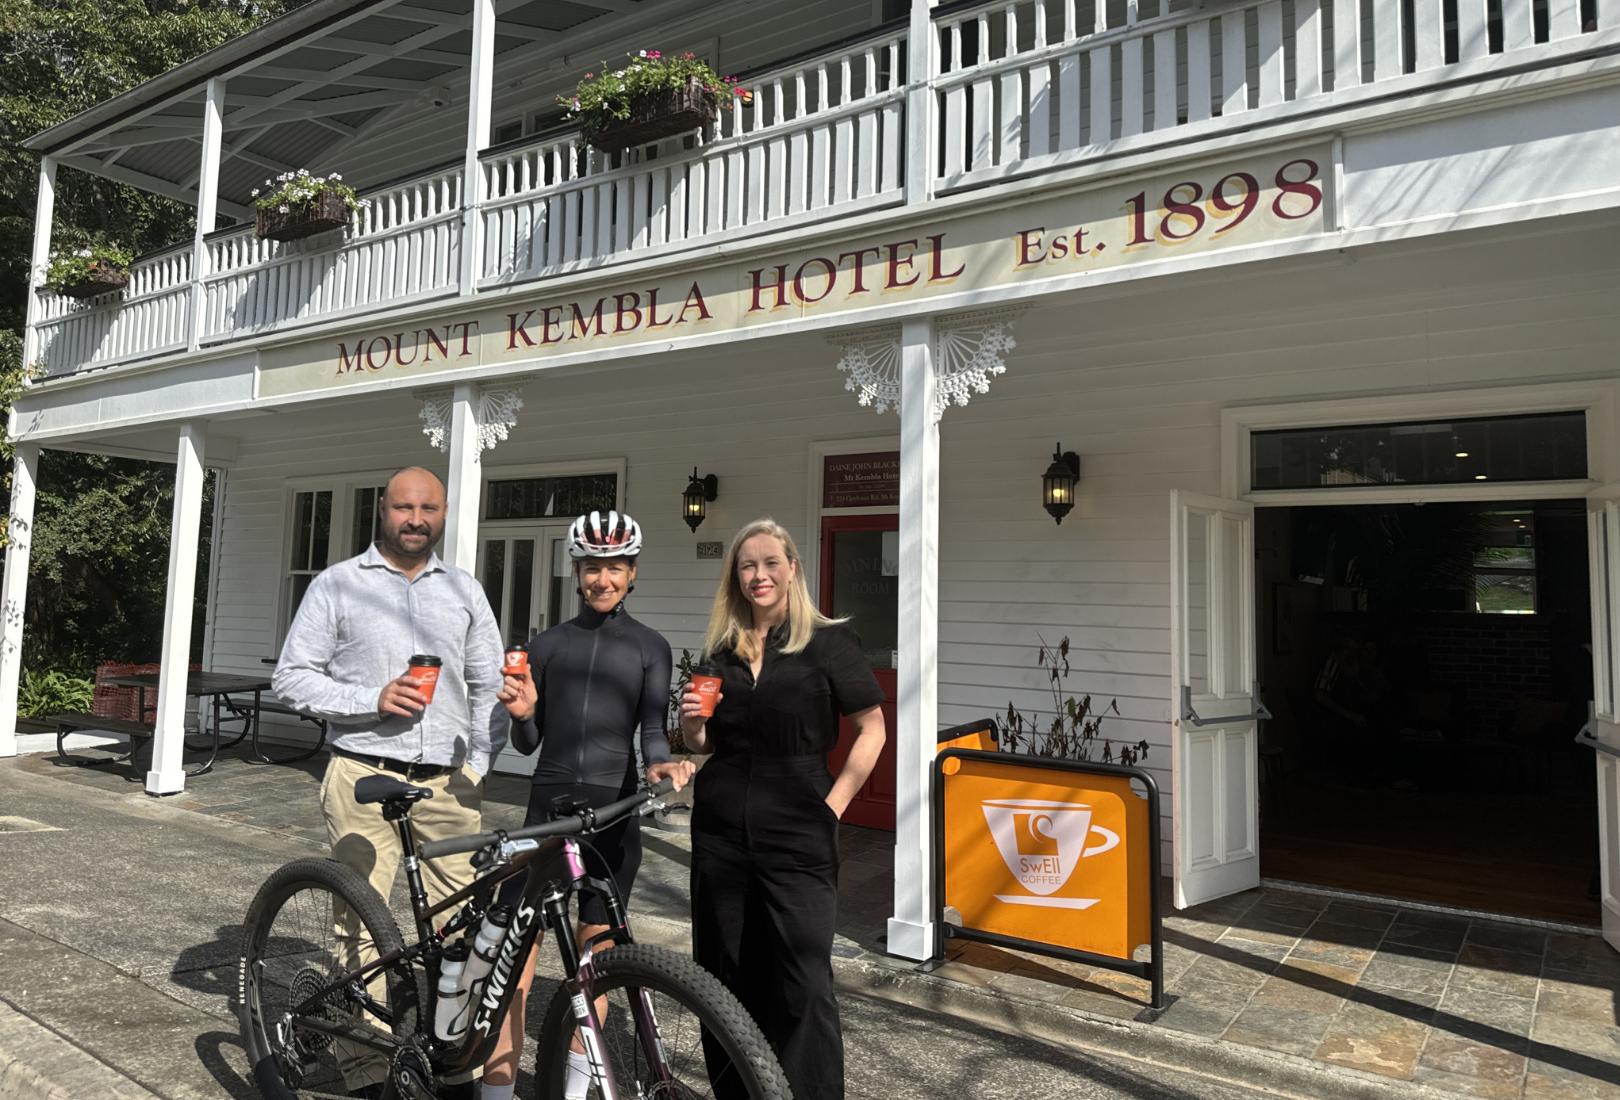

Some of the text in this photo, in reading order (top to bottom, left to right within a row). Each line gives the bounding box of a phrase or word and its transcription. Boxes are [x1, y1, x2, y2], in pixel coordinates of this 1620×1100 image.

[335, 158, 1323, 377] MOUNT KEMBLA HOTEL Est. 1898
[851, 462, 872, 472] JOHN
[873, 461, 900, 469] BLACK
[844, 474, 854, 482] Mt
[855, 473, 882, 481] Kembla
[851, 582, 890, 595] ROOM
[1021, 875, 1062, 885] COFFEE
[474, 897, 535, 1038] S-WORKS
[238, 956, 247, 1005] RENEGADE
